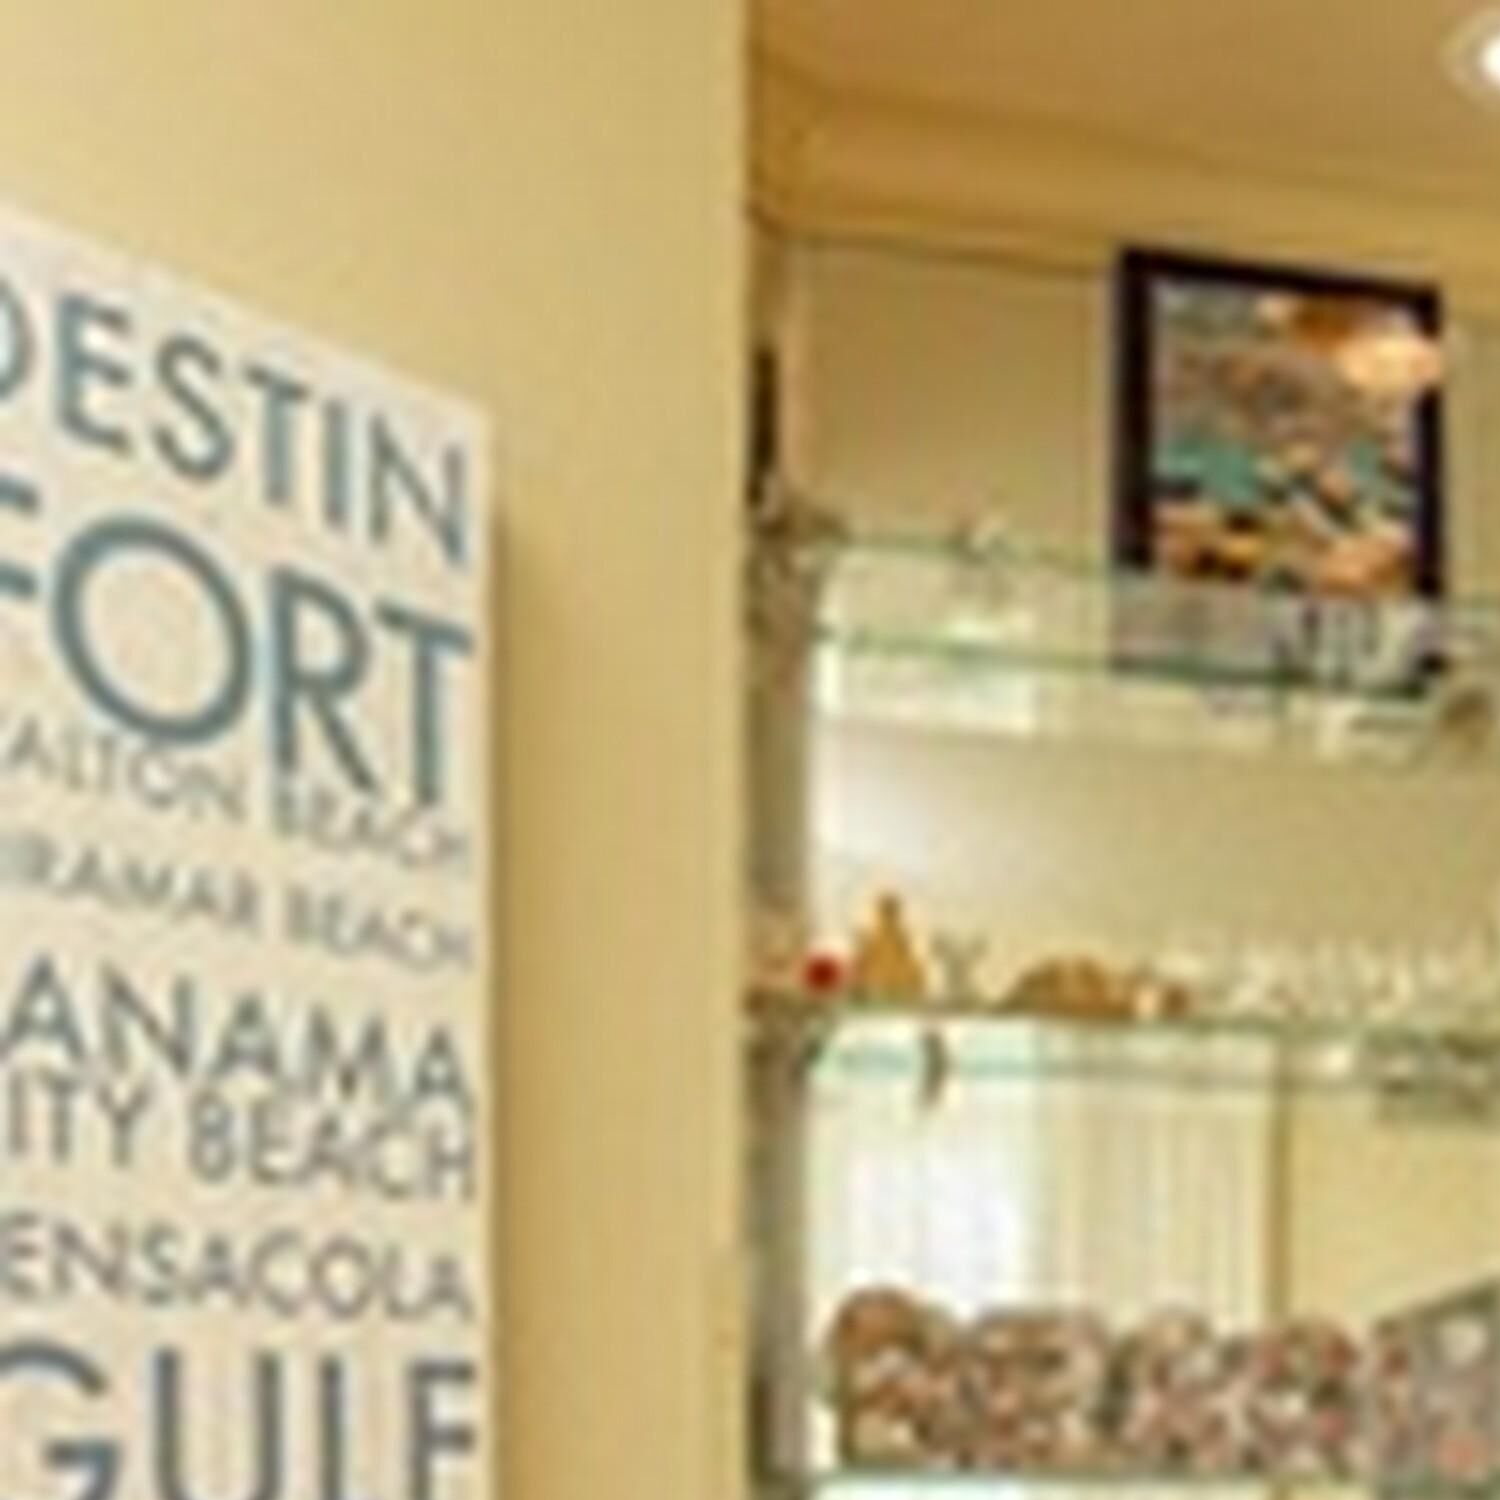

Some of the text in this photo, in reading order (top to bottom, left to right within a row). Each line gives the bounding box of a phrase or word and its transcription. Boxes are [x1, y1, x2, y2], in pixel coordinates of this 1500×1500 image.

[272, 775, 471, 870] BEACH
[285, 884, 473, 971] BEACH
[0, 952, 474, 1112] ANAMA
[8, 1062, 474, 1202] ITY BEACH
[0, 1211, 474, 1320] ENSACOLA
